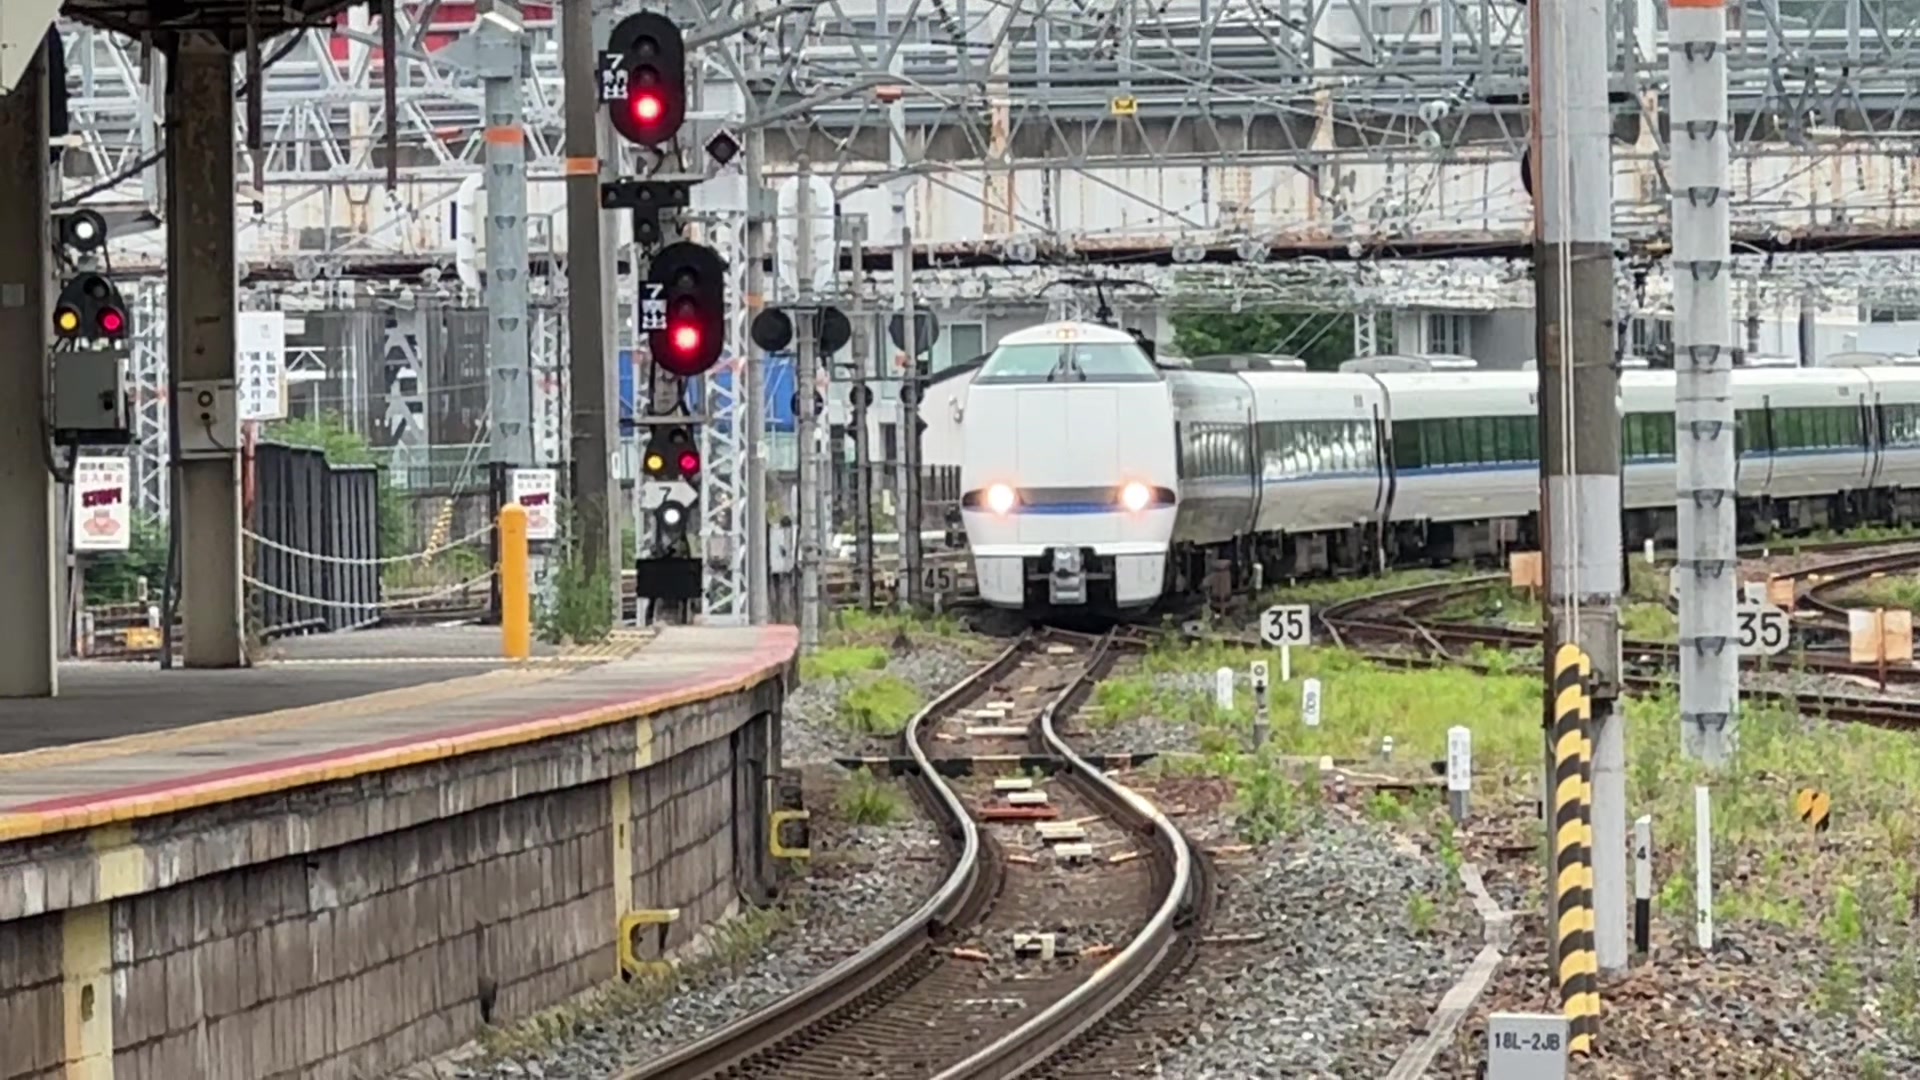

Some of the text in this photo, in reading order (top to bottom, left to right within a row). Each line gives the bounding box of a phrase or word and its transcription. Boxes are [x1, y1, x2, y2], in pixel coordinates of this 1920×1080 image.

[606, 54, 624, 69] 7
[645, 283, 664, 298] 7
[658, 486, 672, 501] 7
[924, 568, 950, 590] 45
[1268, 609, 1303, 641] 35
[1737, 612, 1782, 647] 35
[1637, 846, 1647, 860] 4
[1494, 1031, 1561, 1051] 18L-2JB
